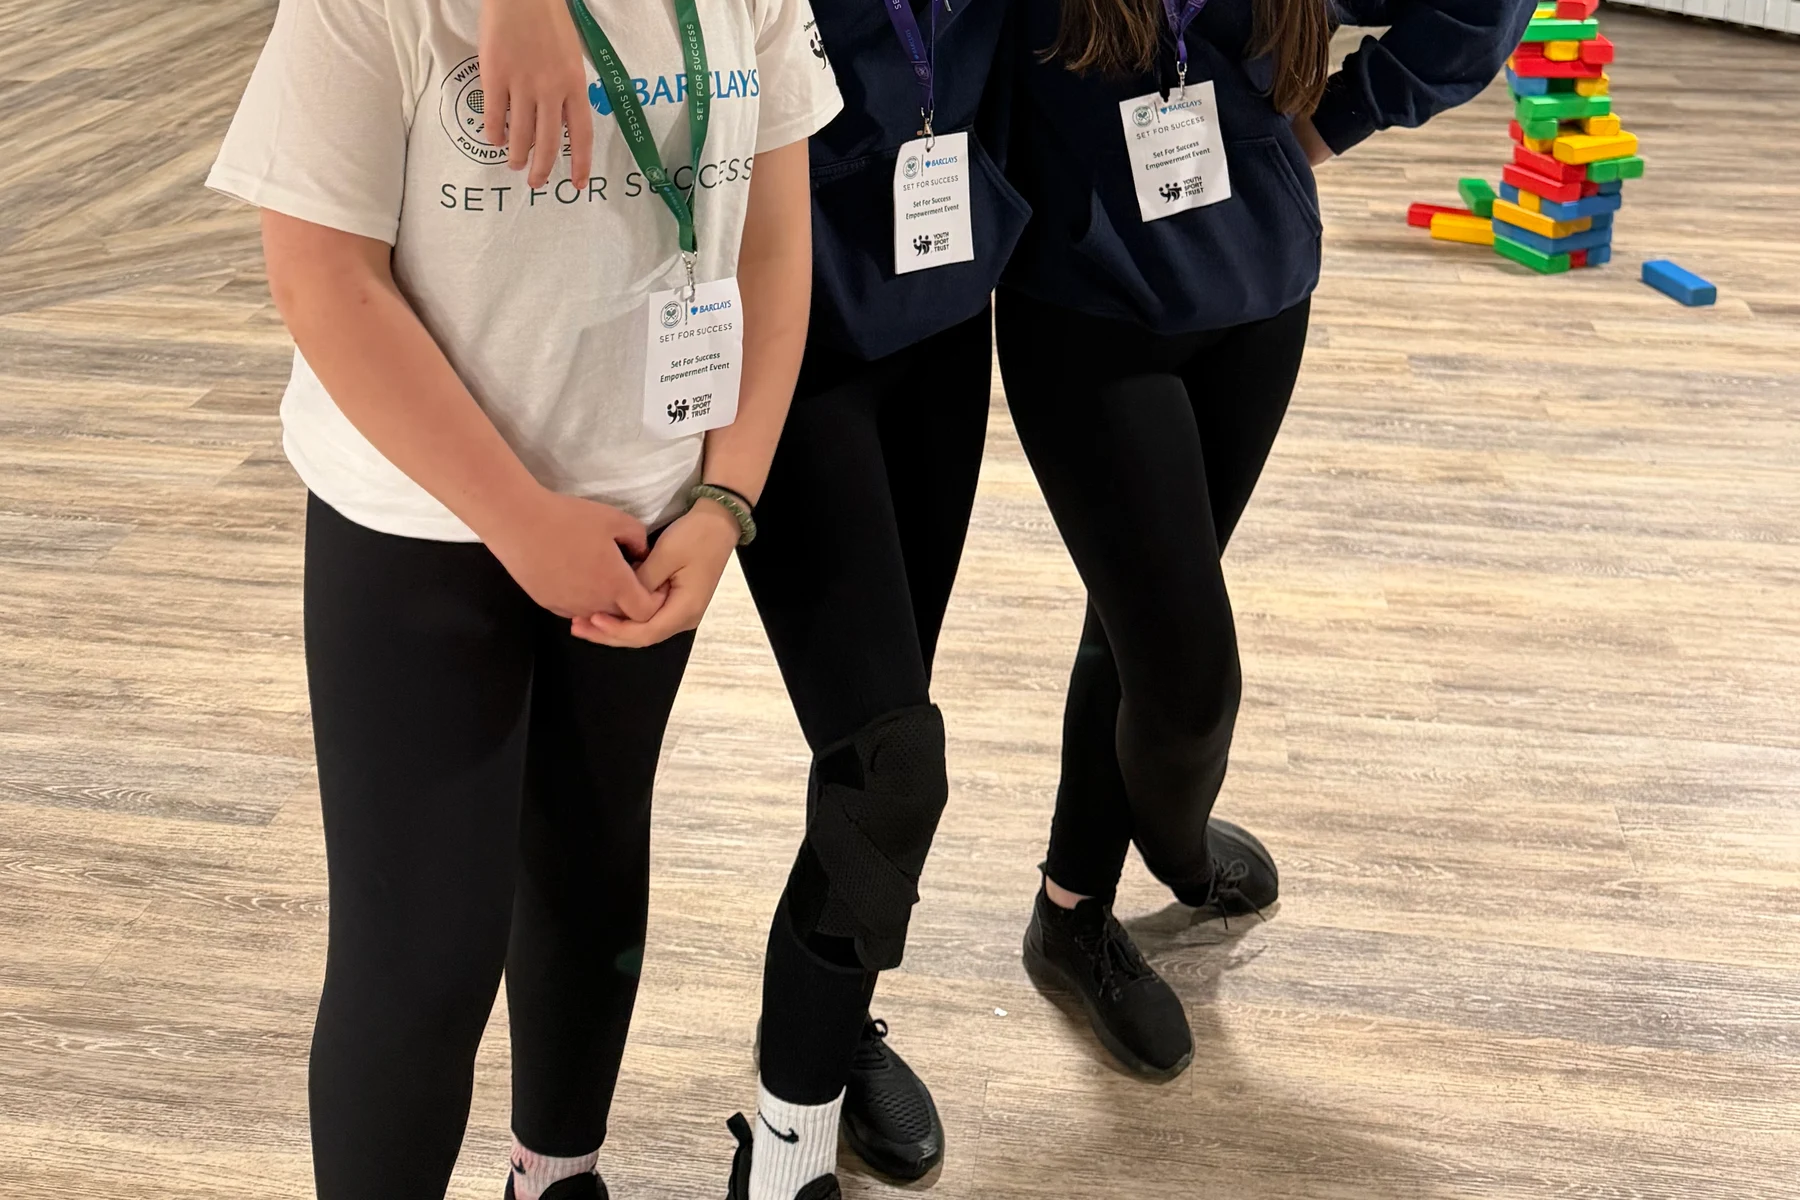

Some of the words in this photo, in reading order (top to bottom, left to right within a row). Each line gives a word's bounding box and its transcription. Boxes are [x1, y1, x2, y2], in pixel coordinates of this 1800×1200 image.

[686, 23, 704, 72] SUCCESS
[696, 78, 704, 97] FOR
[600, 48, 615, 68] SET
[610, 69, 626, 94] FOR
[620, 94, 644, 143] SUCCESS
[1168, 100, 1202, 112] BARCLAYS
[1136, 130, 1151, 140] SET
[1152, 125, 1169, 135] FOR
[1170, 116, 1205, 130] SUCCESS
[1152, 150, 1164, 158] Set
[1165, 148, 1175, 156] For
[1176, 141, 1200, 152] Success
[931, 156, 958, 167] BARCLAYS
[1146, 154, 1192, 170] Empowerment
[1192, 148, 1210, 158] Event
[903, 183, 914, 192] SET
[916, 180, 930, 188] FOR
[932, 175, 959, 186] SUCCESS
[1183, 176, 1202, 184] YOUTH
[1184, 182, 1203, 191] SPORT
[440, 183, 512, 212] SET
[530, 176, 608, 206] FOR
[1185, 188, 1204, 198] TRUST
[913, 200, 922, 208] Set
[922, 198, 931, 206] For
[932, 196, 952, 204] Success
[906, 206, 944, 220] Empowerment
[944, 204, 959, 212] Event
[934, 232, 950, 240] YOUTH
[934, 238, 950, 246] SPORT
[934, 244, 950, 252] TRUST
[700, 300, 732, 314] BARCLAYS
[659, 333, 674, 343] SET
[678, 330, 695, 340] FOR
[696, 323, 732, 336] SUCCESS
[671, 360, 682, 369] Set
[683, 357, 694, 366] For
[695, 352, 720, 364] Success
[660, 366, 708, 383] Empowerment
[710, 362, 730, 372] Event
[692, 394, 712, 403] YOUTH
[692, 400, 711, 410] SPORT
[691, 408, 710, 418] TRUST
